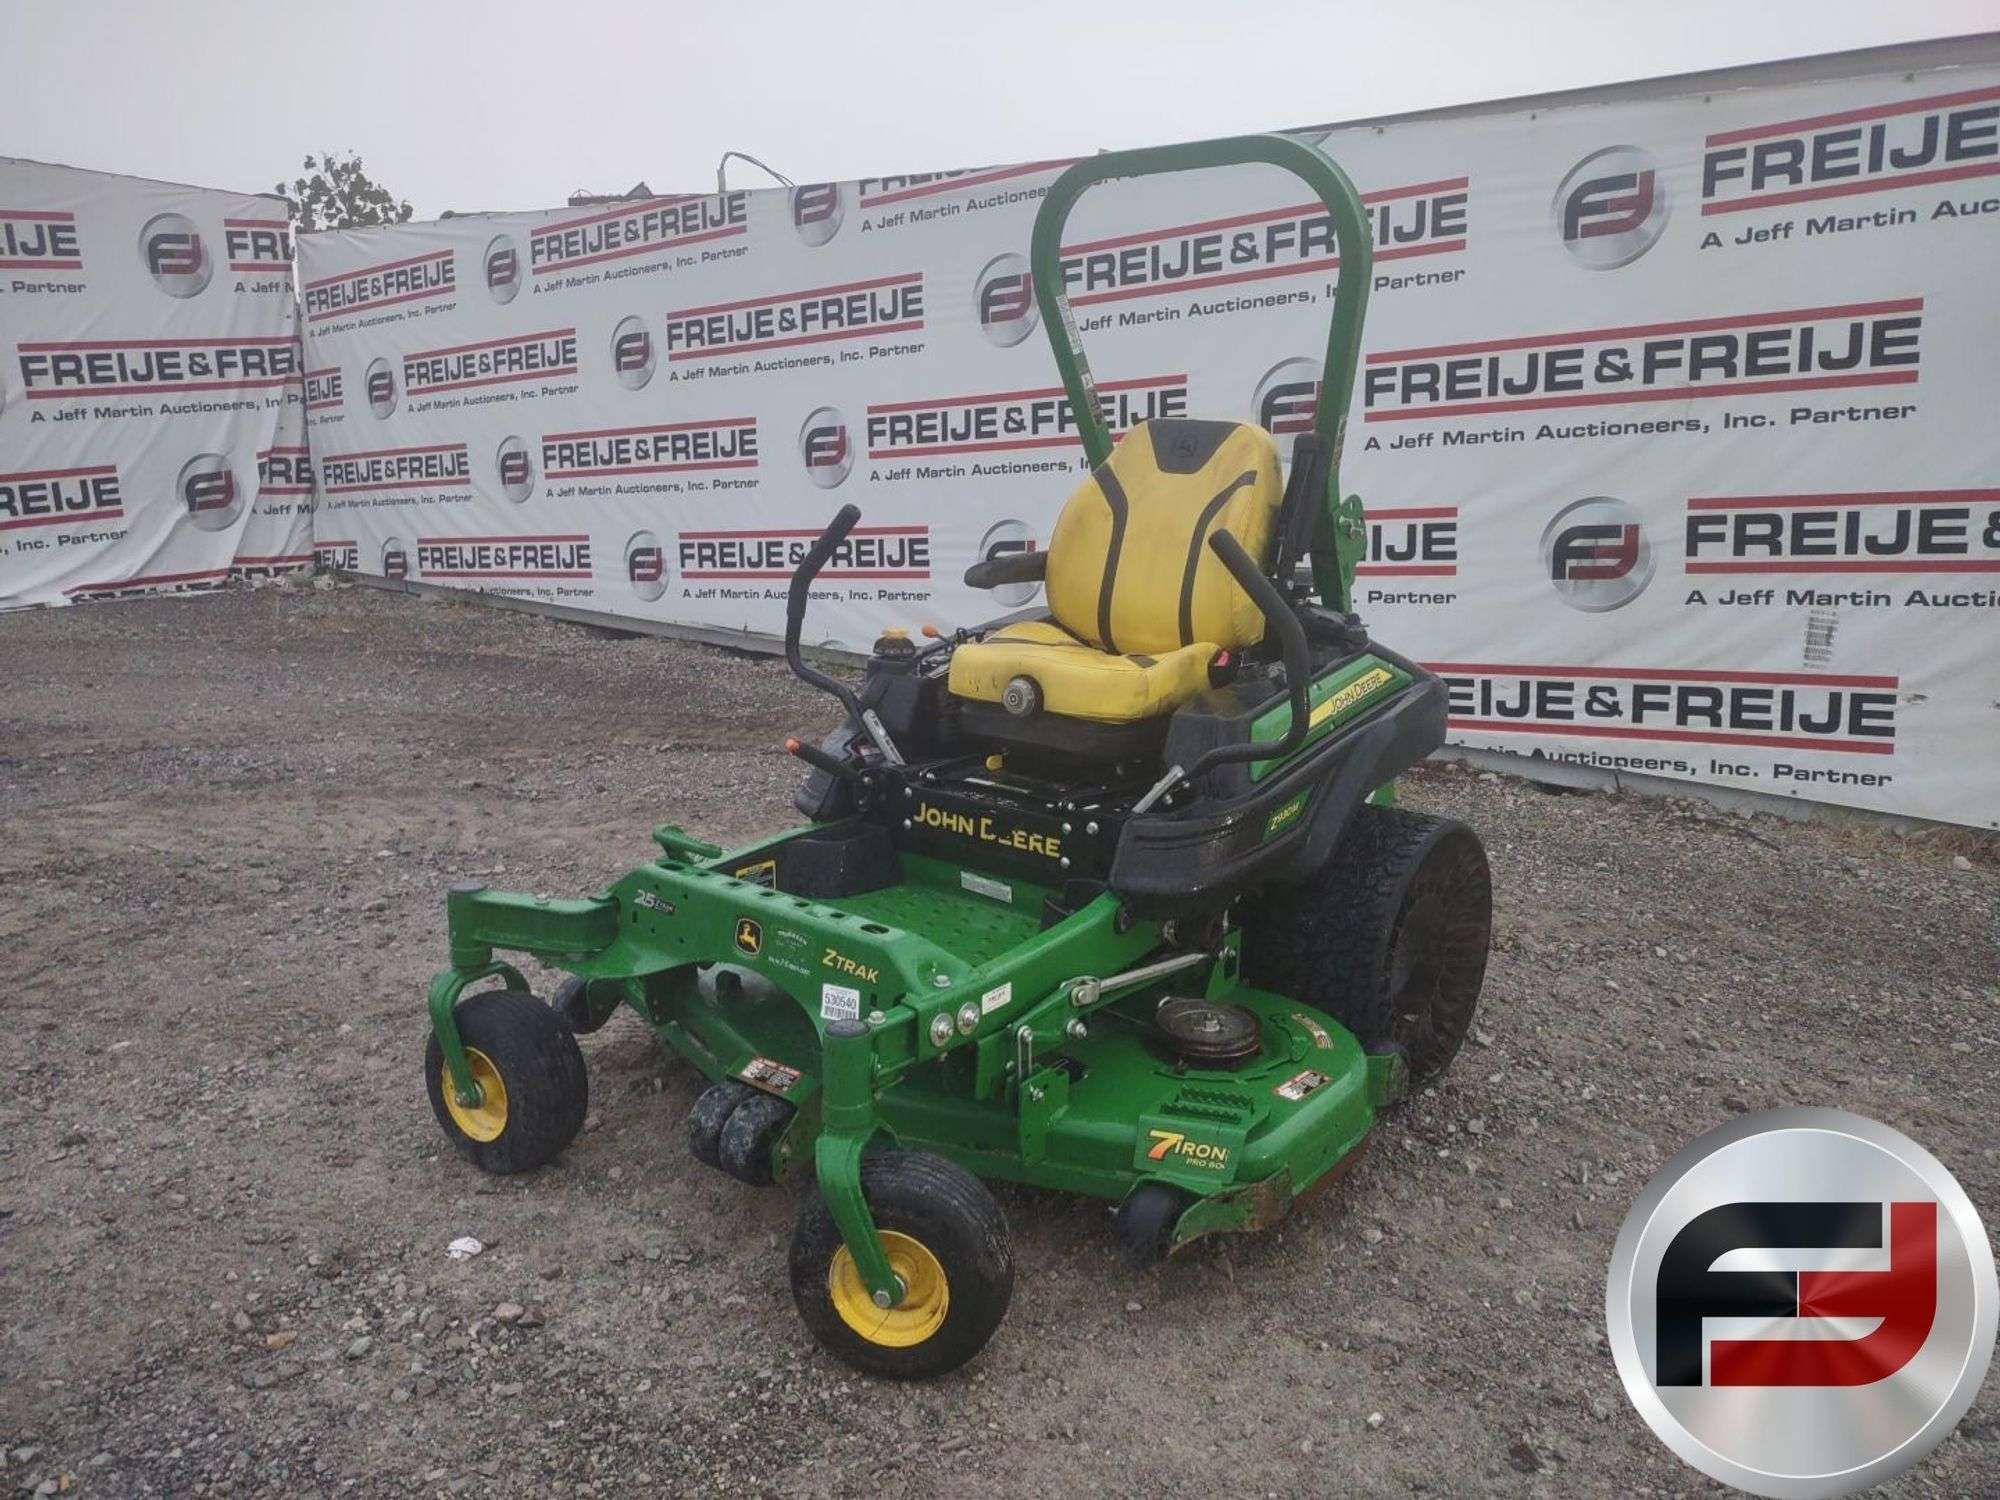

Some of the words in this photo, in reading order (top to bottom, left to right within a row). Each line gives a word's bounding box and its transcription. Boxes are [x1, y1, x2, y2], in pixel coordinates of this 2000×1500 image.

[861, 220, 872, 232] A
[877, 213, 904, 228] Jeff
[910, 204, 960, 223] Martin
[1701, 232, 1723, 249] A
[1735, 222, 1793, 244] Jeff
[1806, 209, 1916, 235] Martin
[1060, 194, 1467, 293] FREIJE&FRIJE
[534, 284, 541, 294] A
[544, 279, 563, 292] Jeff
[566, 274, 600, 288] Martin
[603, 262, 672, 281] Auctioneers,
[677, 257, 696, 267] Inc.
[702, 247, 748, 262] Partner
[1375, 270, 1465, 291] Partner
[12, 281, 86, 293] Partner
[234, 282, 246, 292] A
[251, 282, 280, 293] Jeff
[1077, 315, 1112, 333] Jeff
[1120, 308, 1180, 326] Martin
[1188, 292, 1316, 317] Auctioneers,
[670, 371, 678, 381] A
[683, 368, 704, 380] Jeff
[709, 364, 749, 377] Martin
[754, 356, 834, 372] Auctioneers,
[840, 351, 863, 361] Inc.
[869, 344, 925, 358] Partner
[31, 411, 46, 423] A
[53, 409, 87, 421] Jeff
[94, 405, 153, 419] Martin
[160, 401, 260, 414] Auctioneers,
[408, 404, 414, 412] A
[417, 402, 431, 412] Jeff
[433, 399, 460, 409] Martin
[463, 393, 520, 406] Auctioneers,
[521, 390, 538, 399] Inc.
[542, 386, 578, 399] Partner
[1365, 437, 1380, 450] A
[1390, 433, 1433, 449] Jeff
[1443, 428, 1524, 445] Martin
[1536, 420, 1709, 439] Auctioneers,
[1724, 414, 1775, 428] Inc.
[1791, 406, 1916, 425] Partner
[870, 470, 880, 481] A
[885, 468, 910, 480] Jeff
[917, 465, 965, 479] Martin
[971, 462, 1072, 476] Auctioneers,
[546, 489, 553, 497] A
[557, 487, 575, 497] Jeff
[579, 486, 612, 496] Martin
[616, 483, 683, 494] Auctioneers,
[688, 481, 708, 490] Inc.
[713, 479, 759, 489] Partner
[263, 504, 290, 515] Jeff
[16, 540, 50, 551] Inc.
[58, 531, 128, 546] Partner
[680, 538, 929, 569] FREIJE&REIJE
[538, 588, 553, 596] Inc.
[557, 587, 594, 596] Partner
[683, 589, 691, 598] A
[695, 589, 716, 598] Jeff
[721, 589, 759, 599] Martin
[764, 588, 843, 603] Aucneers,
[849, 590, 872, 600] Inc.
[878, 590, 931, 601] Partner
[1368, 591, 1456, 604] Partner
[1685, 590, 1707, 605] A
[1719, 590, 1774, 605] Jeff
[1787, 590, 1891, 606] Martin
[1329, 689, 1355, 713] JOHN
[1354, 672, 1382, 697] DEERE
[1711, 760, 1758, 777] Inc.
[1774, 764, 1892, 786] Partner
[913, 802, 974, 836] JOHN
[980, 818, 1061, 858] DERE
[822, 948, 879, 984] ZTRAK
